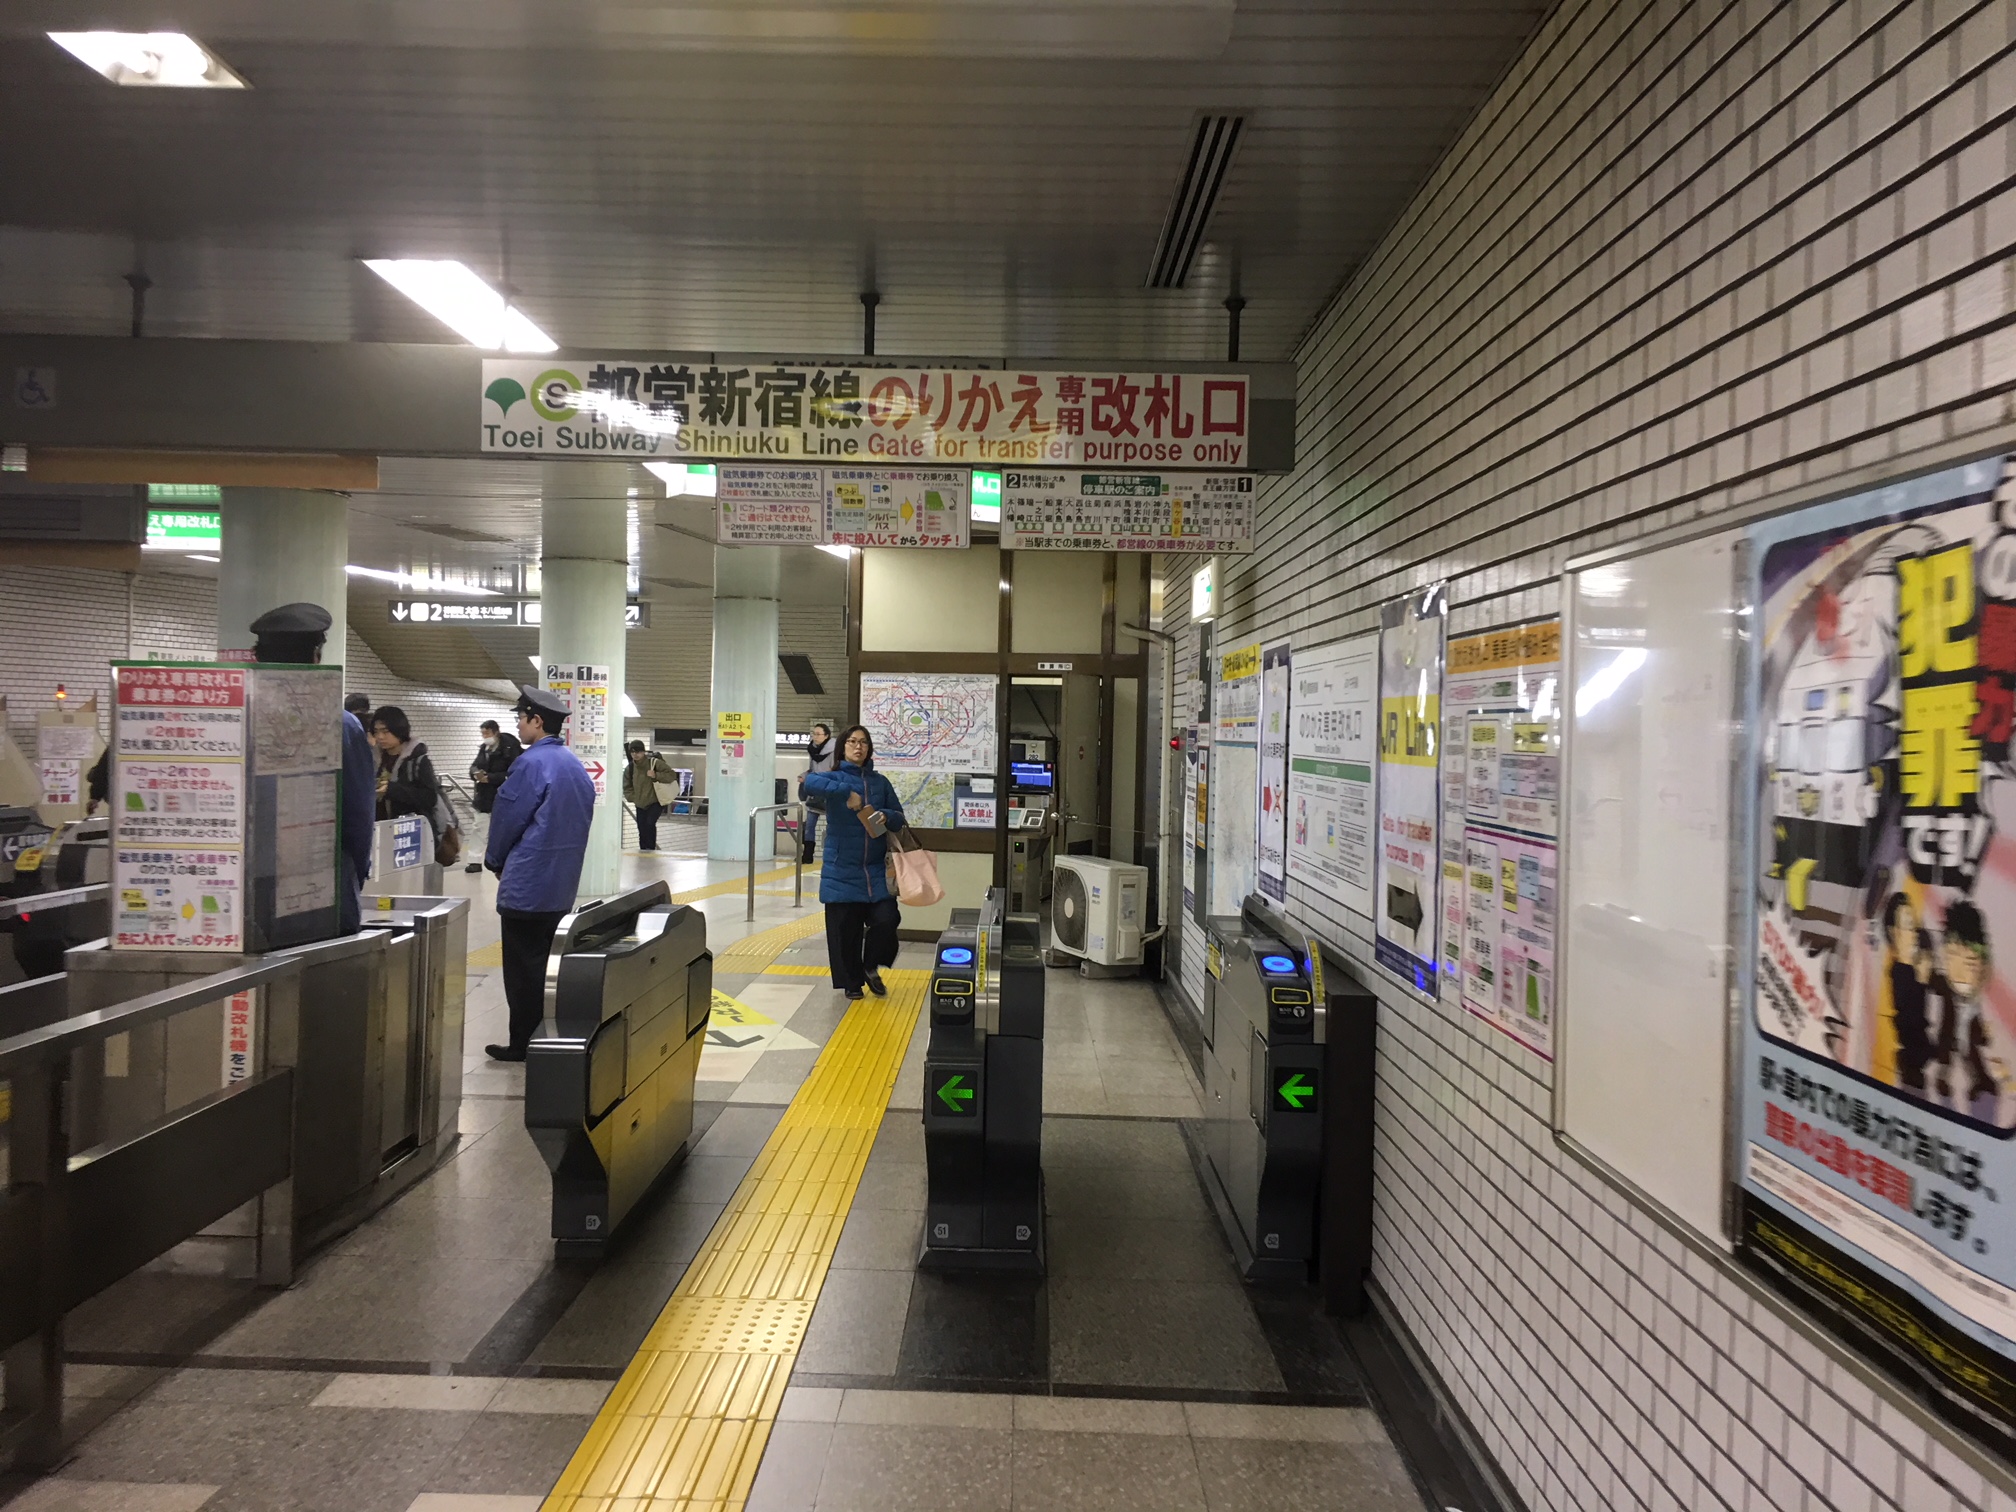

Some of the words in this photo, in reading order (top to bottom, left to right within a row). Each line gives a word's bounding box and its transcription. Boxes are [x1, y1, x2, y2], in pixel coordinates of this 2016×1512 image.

[484, 425, 543, 449] Toei
[556, 426, 662, 453] Subway
[674, 430, 789, 457] Shinjuku
[803, 434, 859, 454] Line
[868, 433, 923, 457] Gate
[935, 435, 968, 457] for
[979, 435, 1074, 460] transfer
[1084, 441, 1182, 463] purpose
[1193, 440, 1242, 464] only
[723, 470, 818, 481] 磁気乗車券でのお乗り換え
[1008, 474, 1018, 488] 2
[836, 486, 856, 495] きっぷ
[1083, 484, 1155, 495] 停車駅のご案内
[868, 513, 897, 521] シルバー
[1006, 498, 1015, 522] 本八幡
[1035, 501, 1043, 522] 一之江
[1055, 499, 1063, 522] 東大島
[1065, 499, 1073, 523] 大島
[1075, 500, 1083, 523] 西大島
[1103, 500, 1111, 524] 森下
[1142, 500, 1150, 524] 小川町
[431, 603, 442, 621] 2
[120, 671, 242, 687] のりかえ専用改札口
[549, 666, 556, 679] 2
[1897, 543, 1982, 807] 犯罪
[726, 713, 741, 721] 出口
[960, 808, 993, 818] 入室禁止
[140, 865, 217, 876] のりかえの場合は
[229, 990, 249, 1086] 動改札機をご
[937, 1226, 947, 1236] 51
[1017, 1228, 1028, 1238] 52
